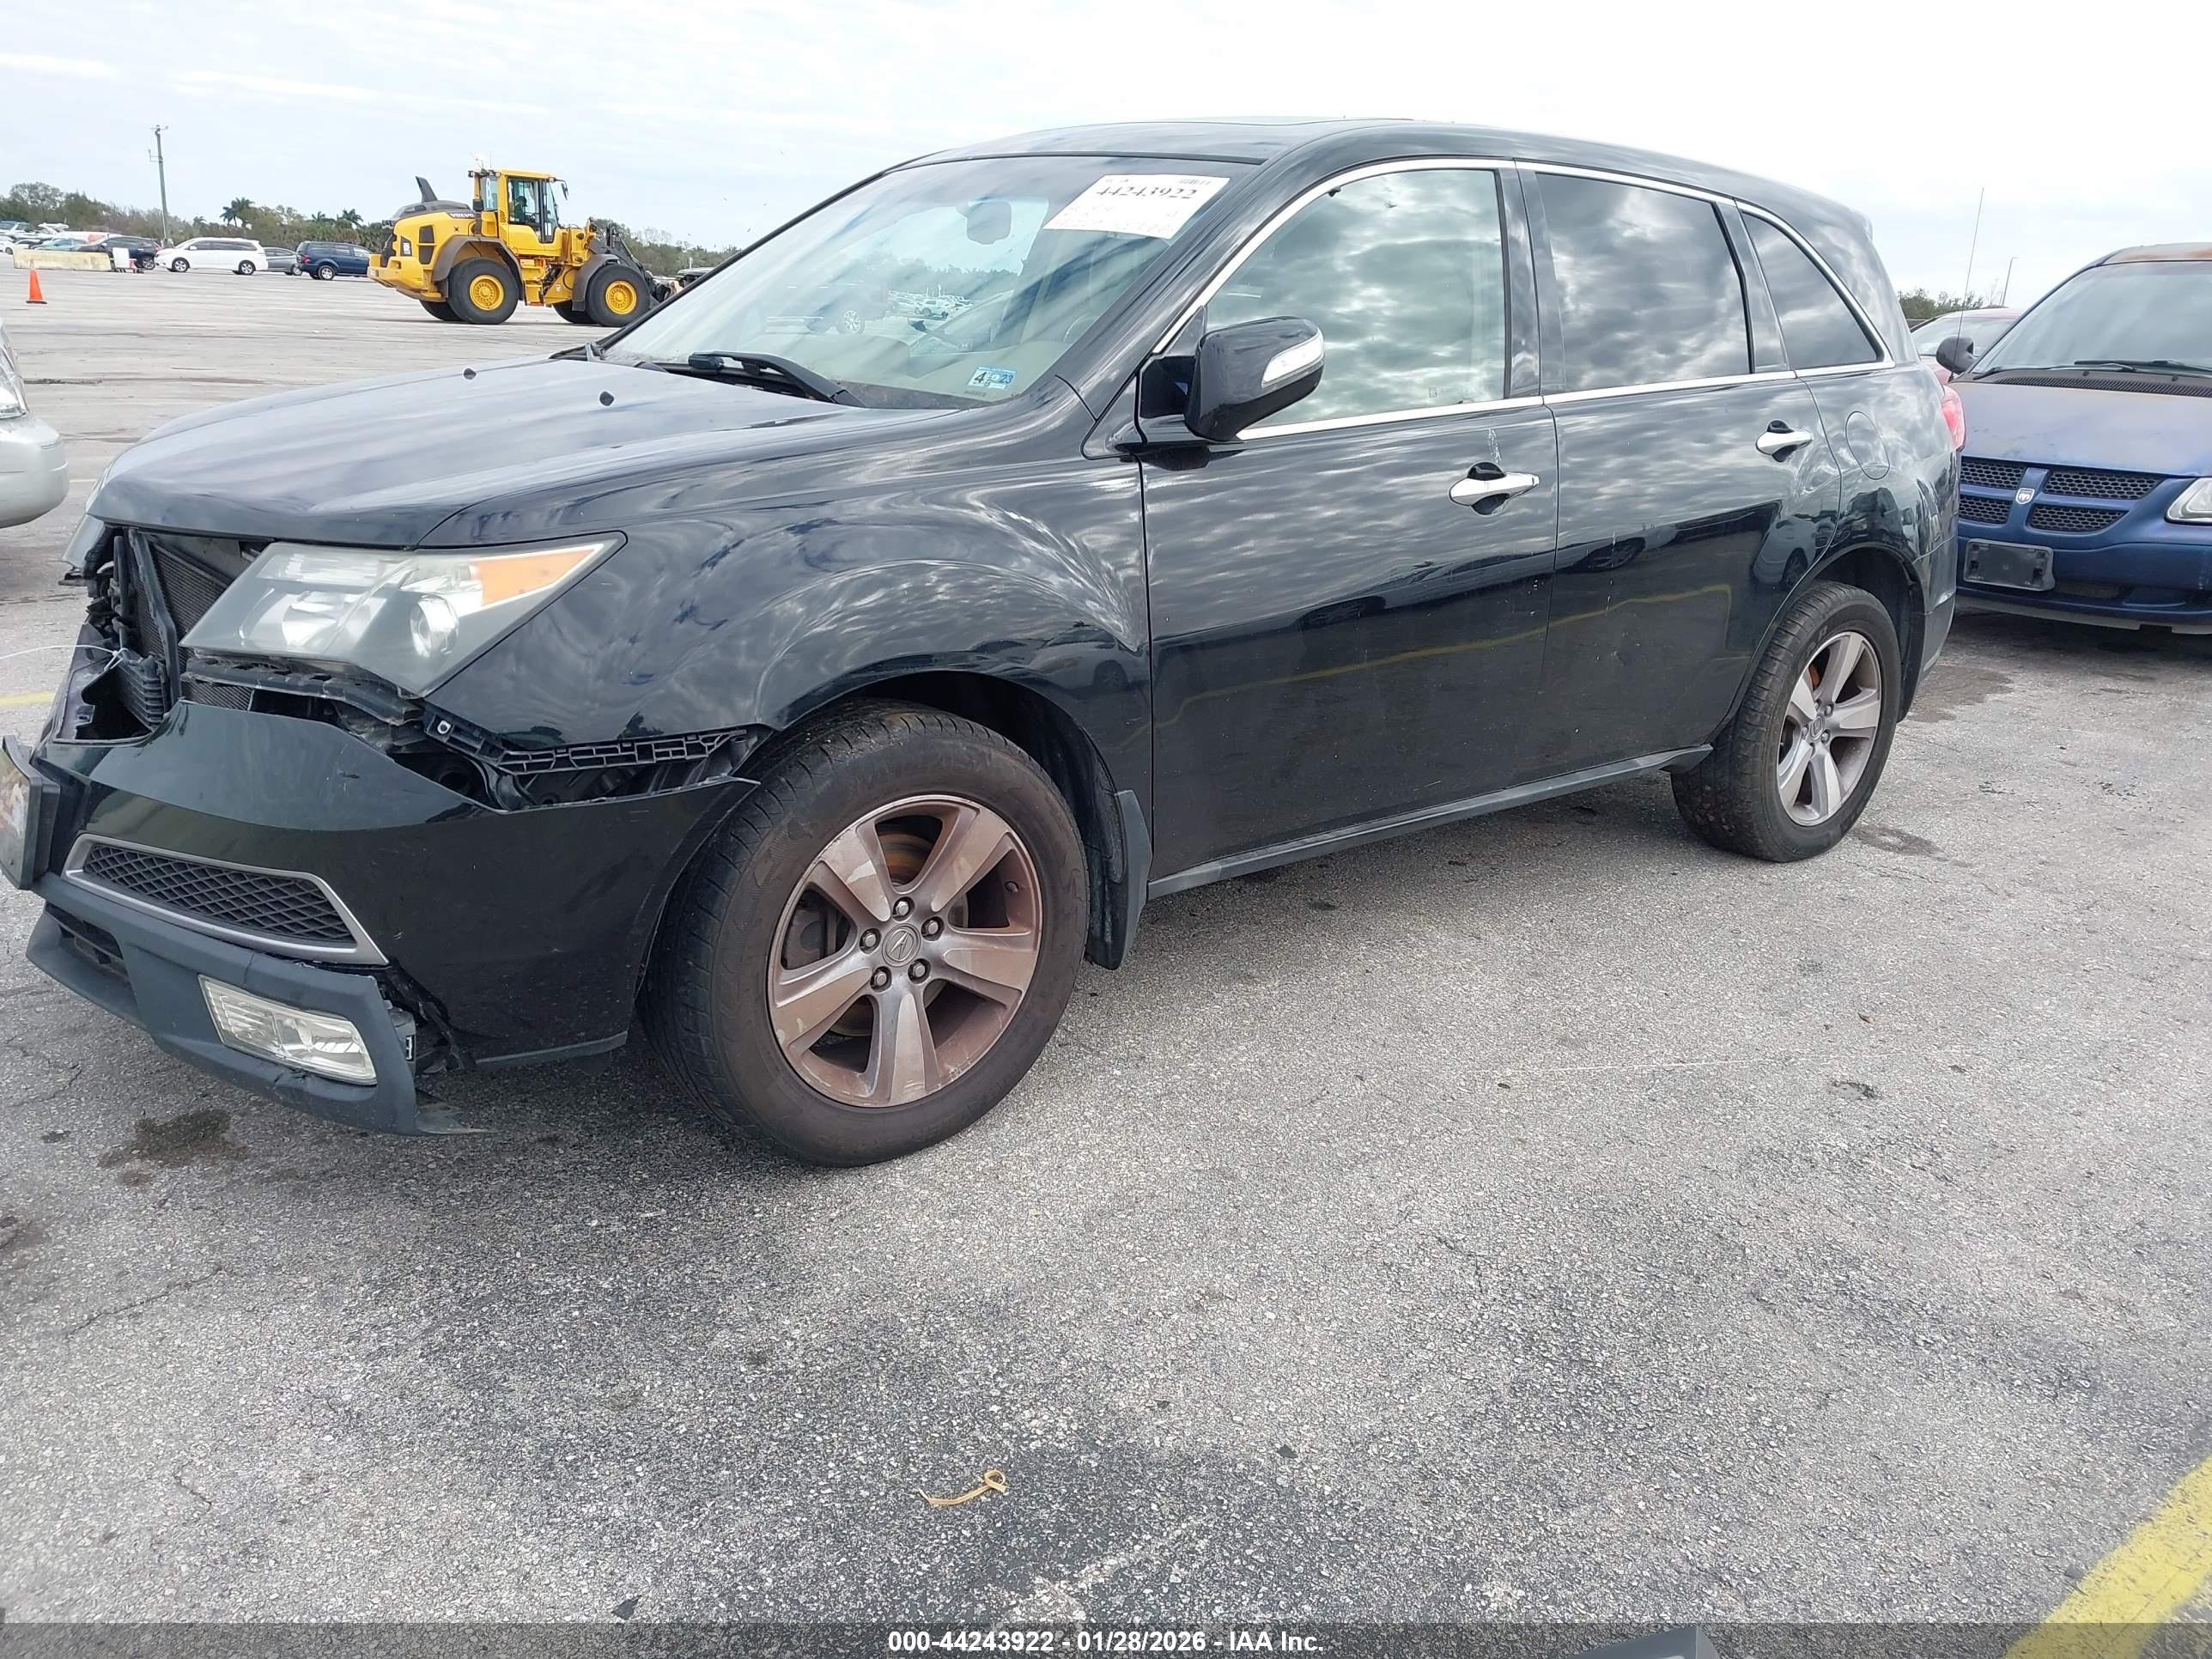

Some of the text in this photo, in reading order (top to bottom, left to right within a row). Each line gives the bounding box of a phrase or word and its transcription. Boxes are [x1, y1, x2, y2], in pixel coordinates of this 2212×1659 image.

[1097, 186, 1197, 199] 44243922
[974, 372, 987, 383] 4
[1000, 374, 1013, 384] 23
